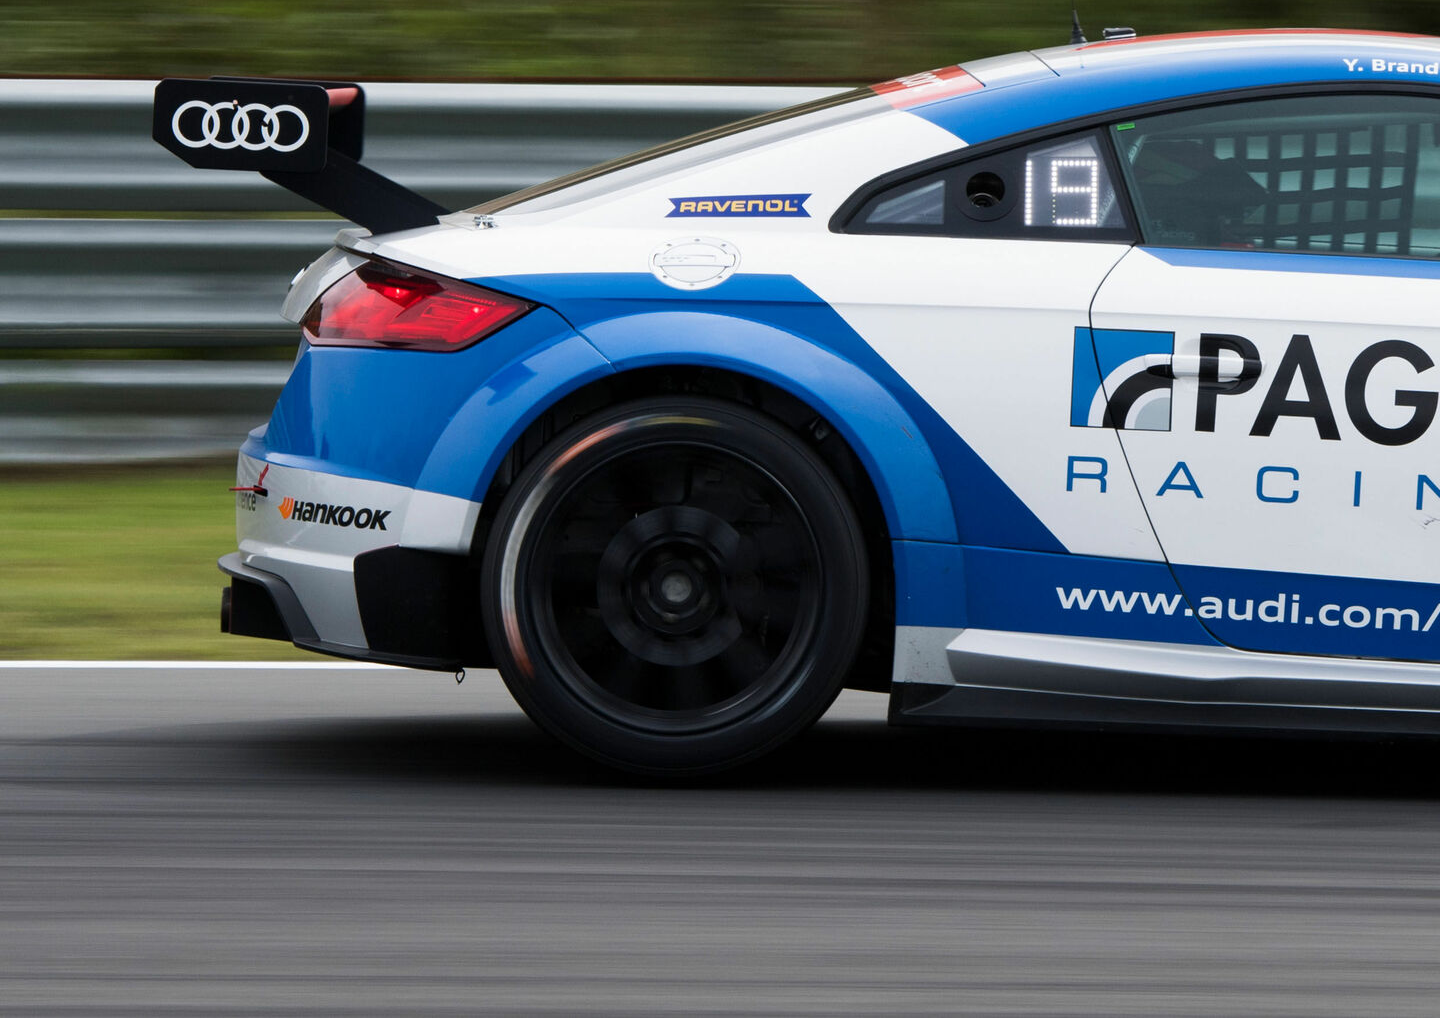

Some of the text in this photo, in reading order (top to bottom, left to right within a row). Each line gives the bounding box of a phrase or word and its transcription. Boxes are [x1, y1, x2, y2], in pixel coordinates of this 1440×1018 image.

[1343, 58, 1364, 72] Y.
[1024, 159, 1098, 227] 19
[679, 199, 799, 213] RAVENOL
